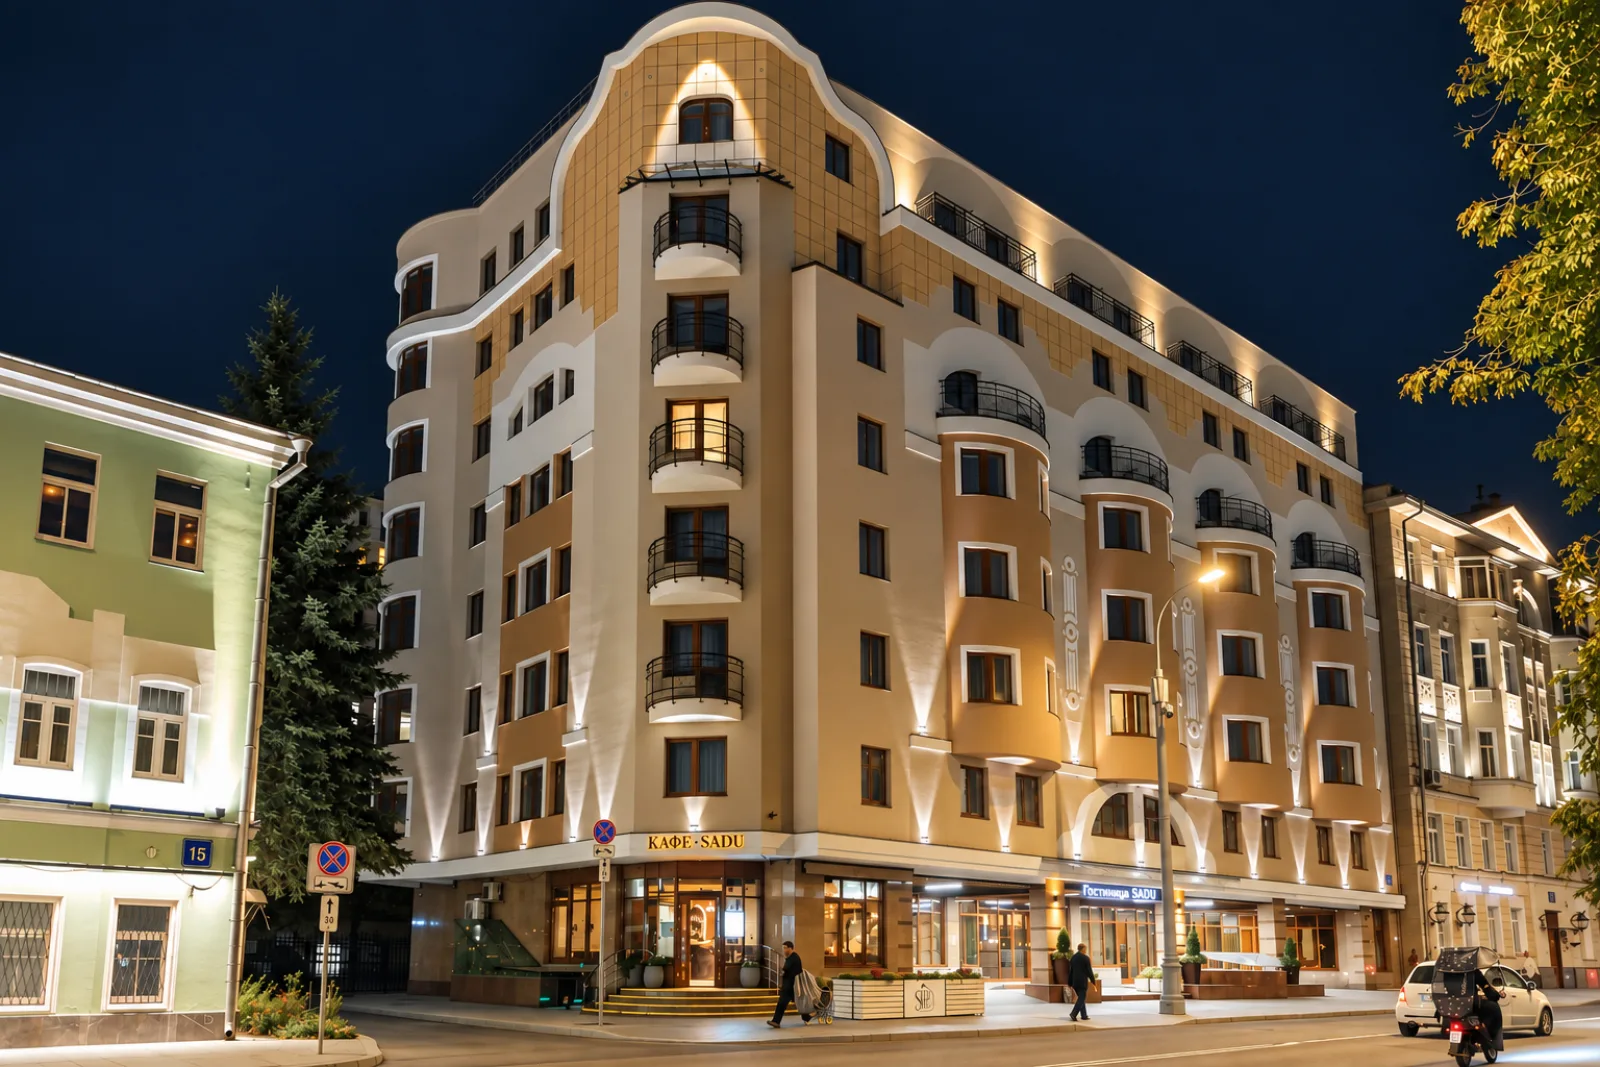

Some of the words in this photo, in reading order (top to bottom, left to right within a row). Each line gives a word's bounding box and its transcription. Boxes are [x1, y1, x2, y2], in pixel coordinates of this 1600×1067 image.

[648, 835, 692, 849] КАФЕ
[700, 834, 744, 848] SADU
[189, 846, 206, 861] 15
[1082, 884, 1129, 900] Гостиница
[1131, 887, 1157, 899] SADU
[324, 916, 334, 924] 30
